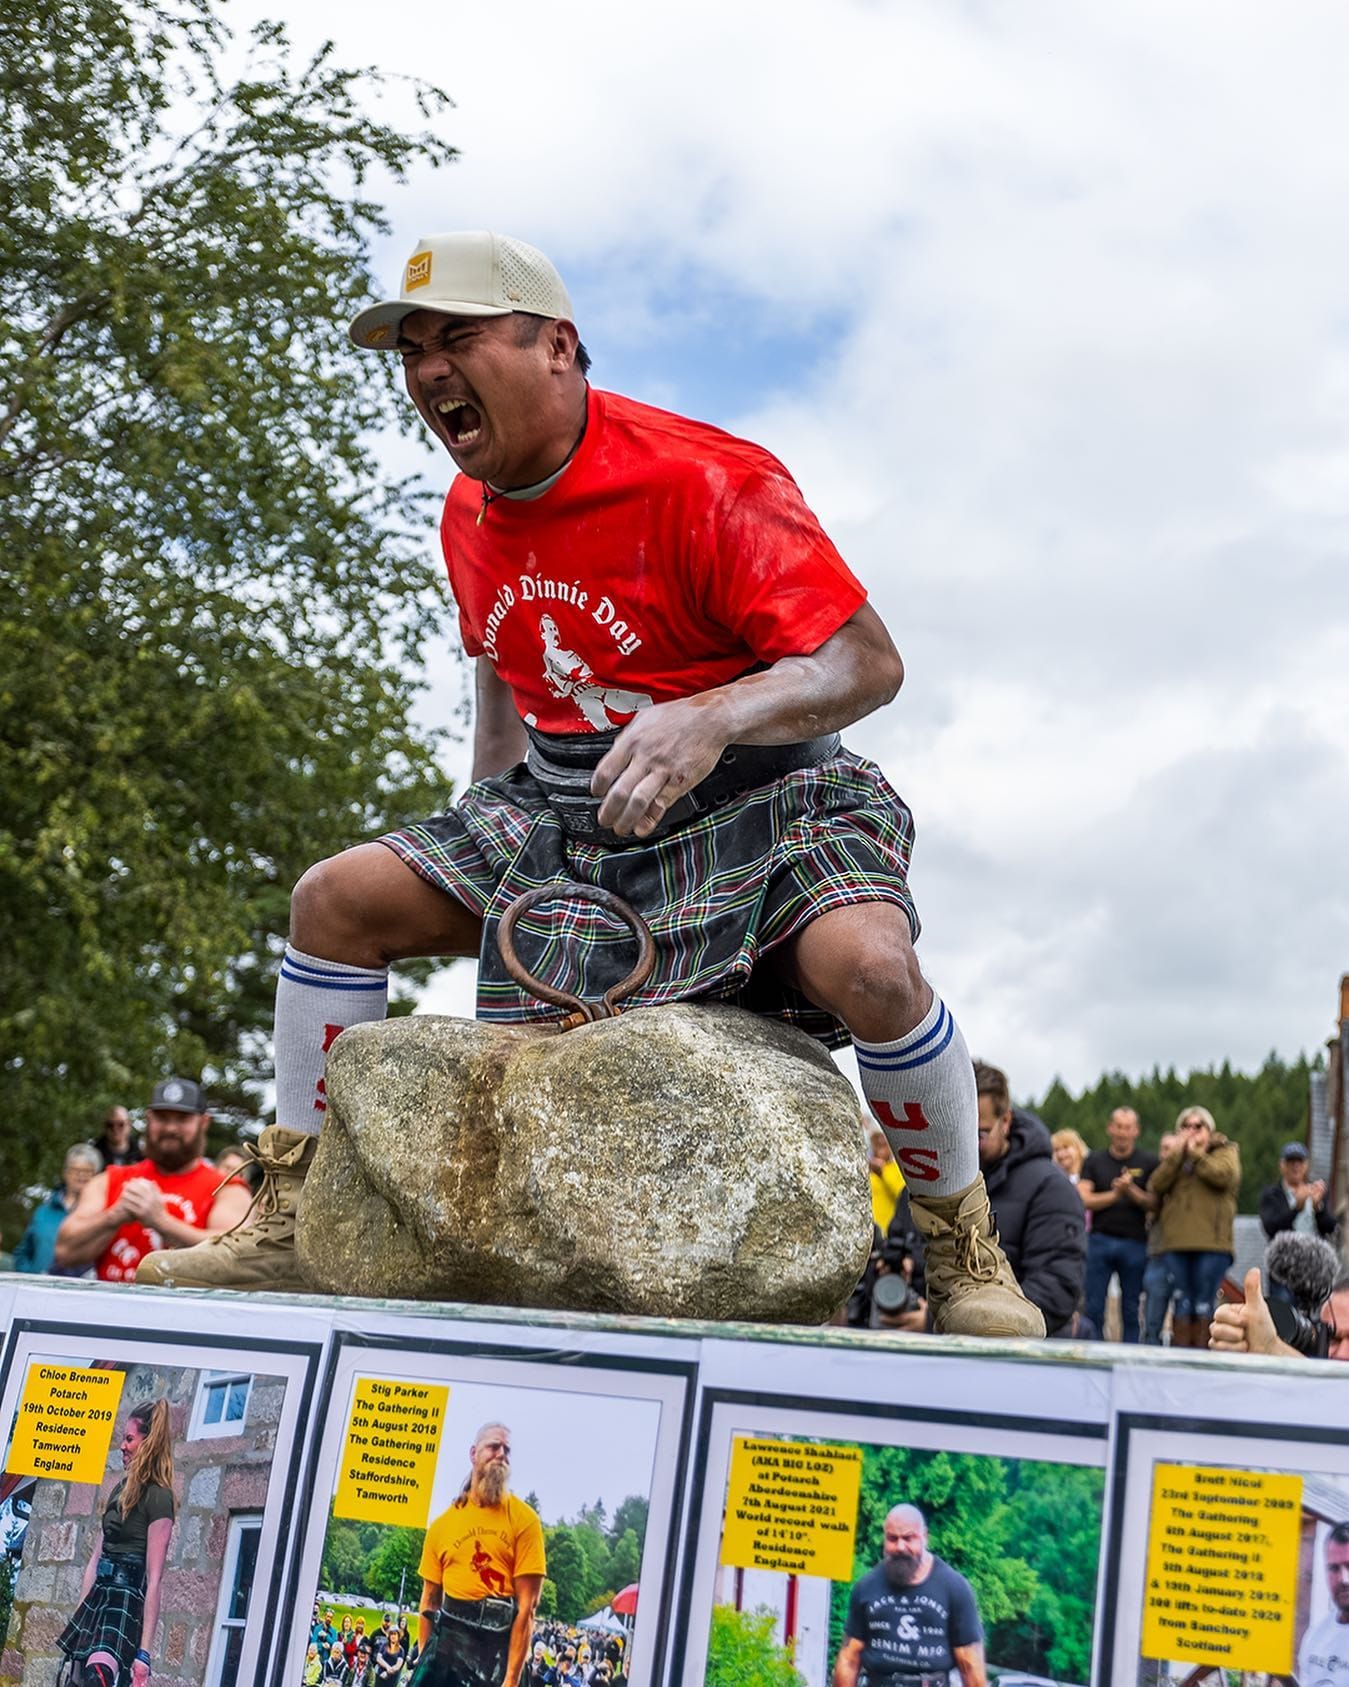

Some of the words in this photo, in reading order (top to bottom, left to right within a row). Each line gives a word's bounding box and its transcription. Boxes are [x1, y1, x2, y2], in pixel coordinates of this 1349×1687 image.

[483, 584, 515, 661] Donald
[519, 573, 588, 610] Dinnie
[592, 596, 642, 656] Day
[40, 1369, 67, 1383] Chloe
[69, 1372, 109, 1385] Brennan
[50, 1388, 88, 1400] Potarch
[371, 1384, 391, 1396] Stig
[394, 1386, 429, 1398] Parker
[24, 1402, 43, 1415] 19th
[47, 1405, 86, 1419] October
[89, 1409, 112, 1421] 2019
[356, 1399, 374, 1411] The
[378, 1402, 428, 1418] Gathering
[432, 1408, 440, 1417] II
[36, 1422, 86, 1437] Residence
[352, 1417, 368, 1427] 5th
[372, 1419, 408, 1432] August
[411, 1423, 437, 1435] 2018
[32, 1439, 81, 1454] Tamworth
[350, 1434, 368, 1445] The
[371, 1437, 422, 1453] Gathering
[425, 1443, 436, 1453] III
[743, 1441, 801, 1454] Lawrence
[34, 1457, 73, 1472] England
[362, 1453, 415, 1468] Residence
[752, 1456, 779, 1467] (AKA
[783, 1460, 803, 1469] BIG
[807, 1461, 834, 1474] LOZ)
[349, 1469, 419, 1488] Staffordshire,
[758, 1472, 769, 1480] at
[772, 1472, 820, 1485] Potarch
[356, 1488, 408, 1503] Tamworth
[748, 1484, 837, 1501] Aberdeenshire
[743, 1496, 761, 1507] 7th
[764, 1499, 806, 1512] August
[810, 1505, 836, 1516] 2021
[736, 1510, 771, 1522] World
[774, 1515, 815, 1528] record
[820, 1521, 849, 1531] walk
[1171, 1507, 1193, 1519] The
[1198, 1511, 1258, 1527] Gathering
[757, 1527, 769, 1536] of
[1190, 1526, 1232, 1541] August
[753, 1541, 815, 1556] Residence
[1161, 1543, 1183, 1554] The
[1187, 1546, 1248, 1563] Gathering
[754, 1555, 805, 1569] England
[1186, 1562, 1229, 1578] August
[1196, 1582, 1244, 1600] January
[897, 1614, 921, 1641] &
[1176, 1637, 1232, 1653] Scotland
